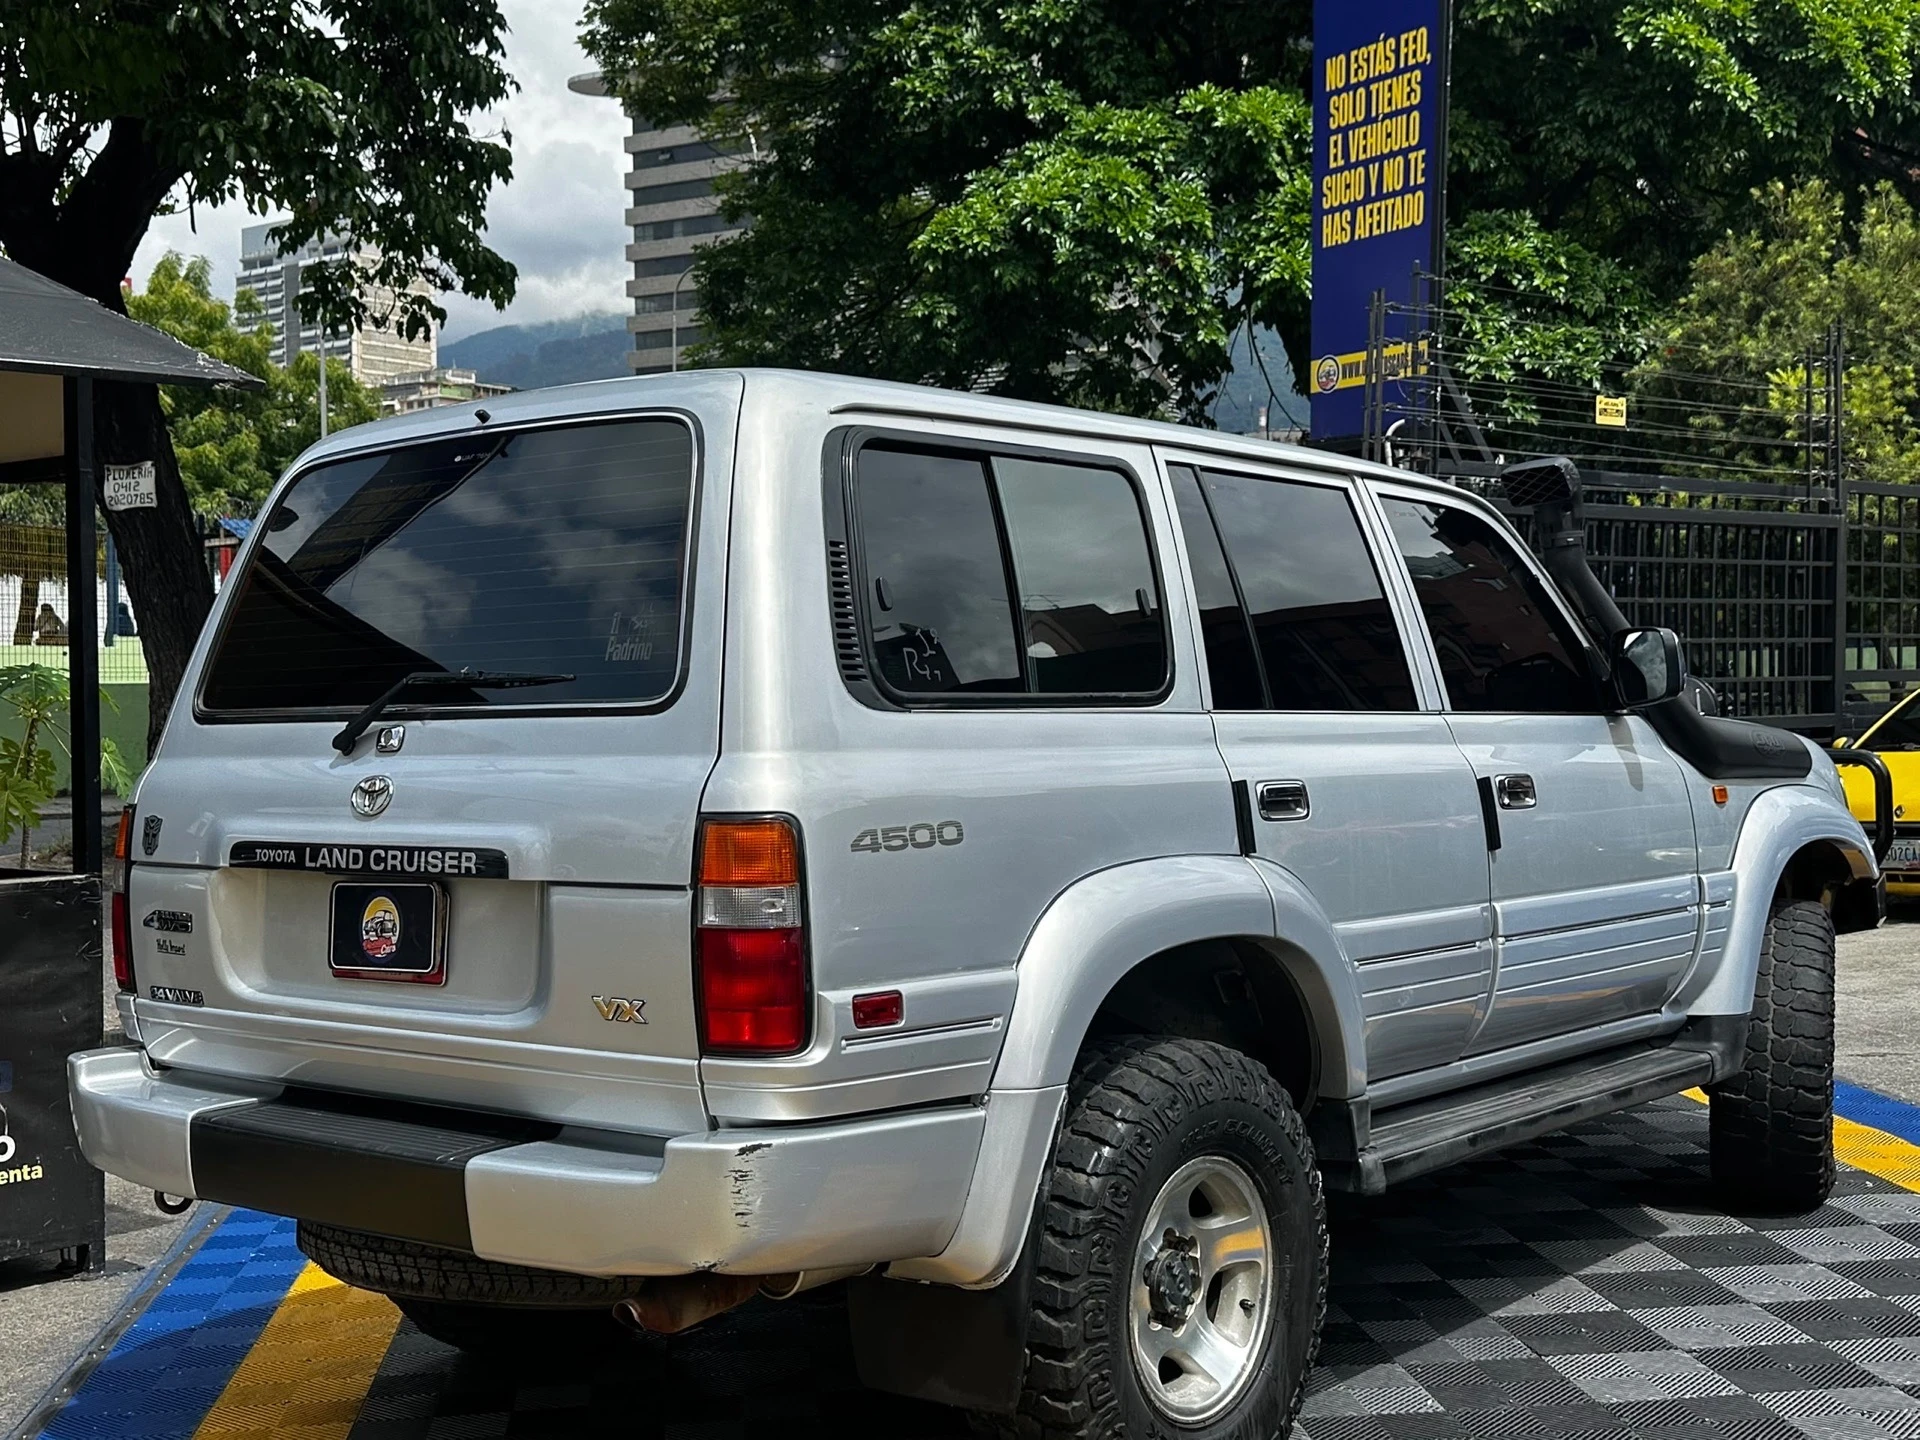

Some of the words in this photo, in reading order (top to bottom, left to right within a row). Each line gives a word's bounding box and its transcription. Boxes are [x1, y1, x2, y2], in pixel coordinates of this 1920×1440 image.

[1325, 54, 1346, 92] NO
[1350, 32, 1395, 84] ESTÁS
[1399, 26, 1431, 69] FEO,
[1329, 87, 1365, 130] SOLO
[1370, 69, 1421, 118] TIENES
[1329, 133, 1345, 169] EL
[1348, 110, 1420, 163] VEHÍCULO
[1322, 166, 1365, 209] SUCIO
[1369, 162, 1380, 197] Y
[1383, 155, 1404, 194] NO
[1408, 149, 1426, 187] TE
[1322, 209, 1351, 248] HAS
[1354, 190, 1424, 240] AFEITADO
[108, 492, 154, 506] 2020785
[113, 481, 140, 493] 0412
[605, 636, 653, 661] Padrino
[850, 820, 964, 853] 4500
[255, 849, 296, 864] TOYOTA
[304, 847, 364, 870] LAND
[369, 849, 477, 875] CRUISER
[591, 995, 649, 1025] VX
[1223, 1118, 1294, 1184] COUNTRY
